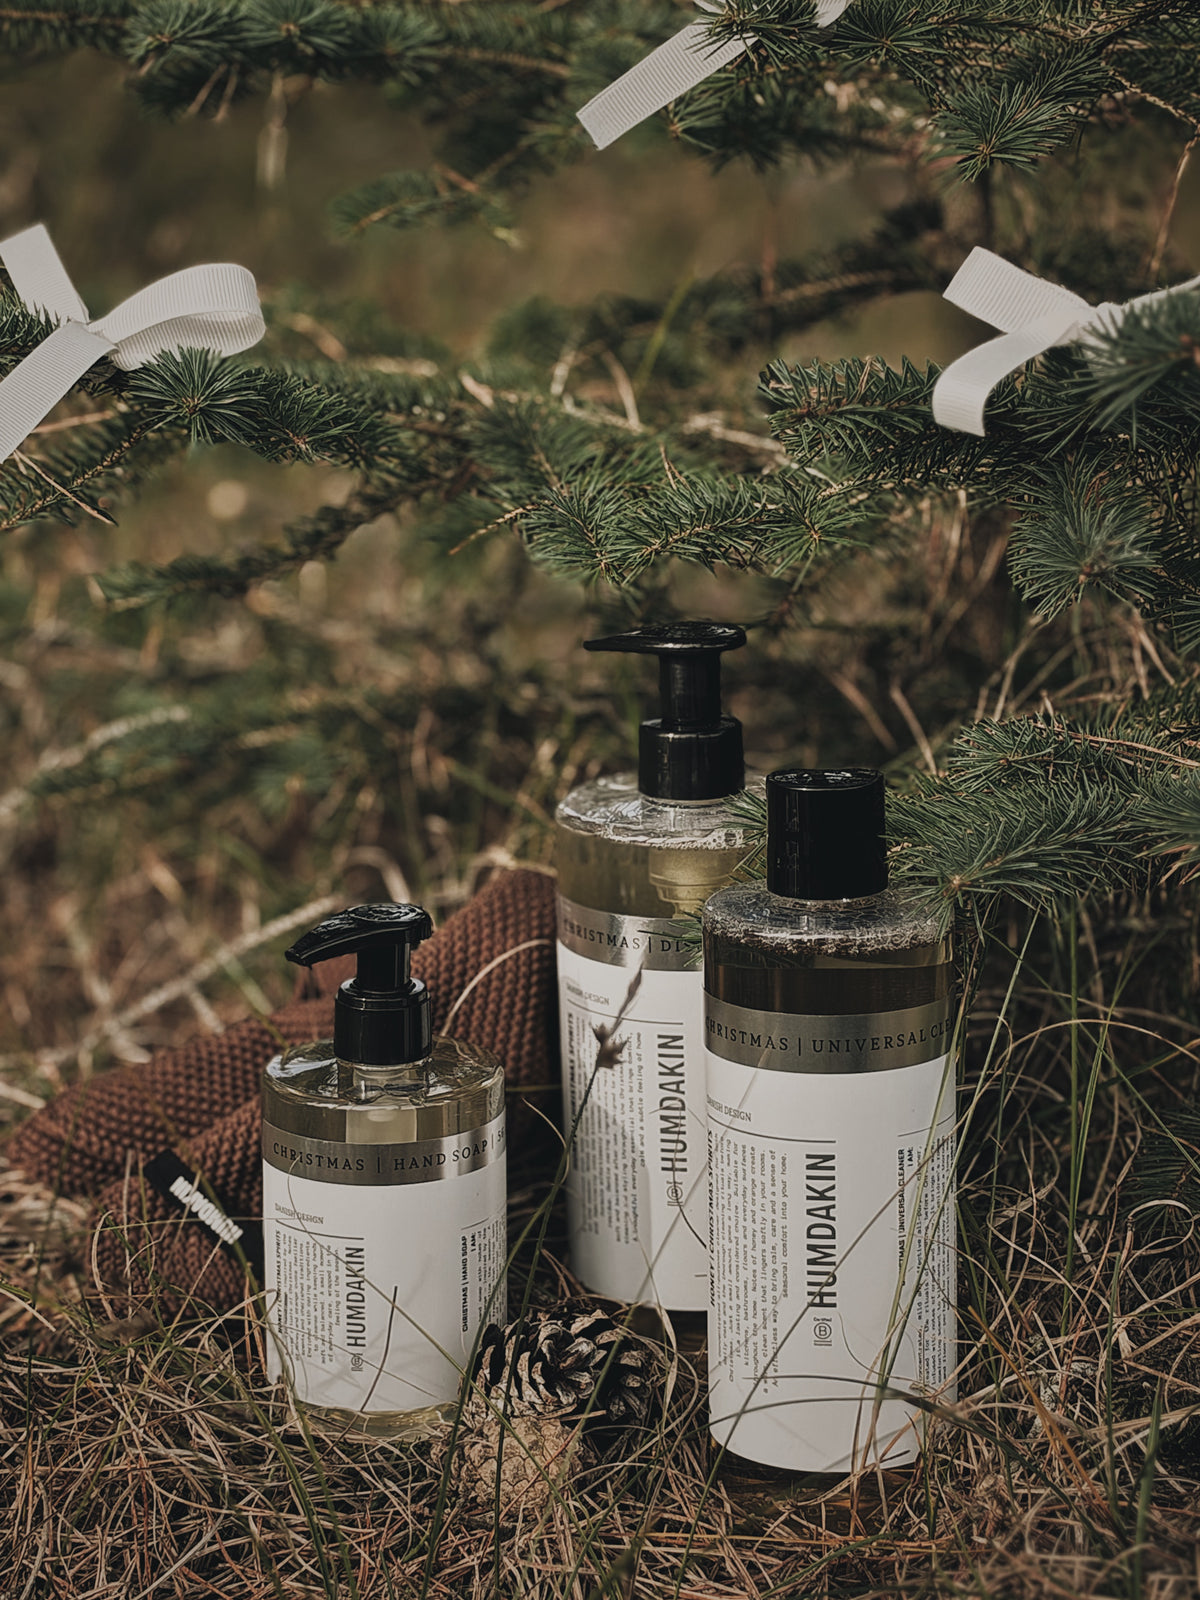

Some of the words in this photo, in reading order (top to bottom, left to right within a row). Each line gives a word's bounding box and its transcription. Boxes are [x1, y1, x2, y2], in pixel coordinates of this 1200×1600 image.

[706, 1017, 788, 1050] CHRISTMAS
[812, 1029, 926, 1053] UNIVERSAL
[636, 1053, 642, 1062] of
[657, 1034, 687, 1172] HUMDAKIN
[724, 1106, 752, 1122] DESIGN
[273, 1143, 364, 1171] CHRISTMAS
[394, 1153, 447, 1171] HAND
[452, 1140, 488, 1162] SOAP
[769, 1149, 776, 1160] of
[760, 1202, 766, 1212] in
[805, 1154, 836, 1308] HUMDAKIN
[750, 1254, 756, 1265] of
[760, 1248, 768, 1280] lingers
[770, 1242, 778, 1265] calm,
[770, 1268, 778, 1292] bring
[345, 1247, 365, 1347] HUMDAKIN
[771, 1295, 777, 1305] to
